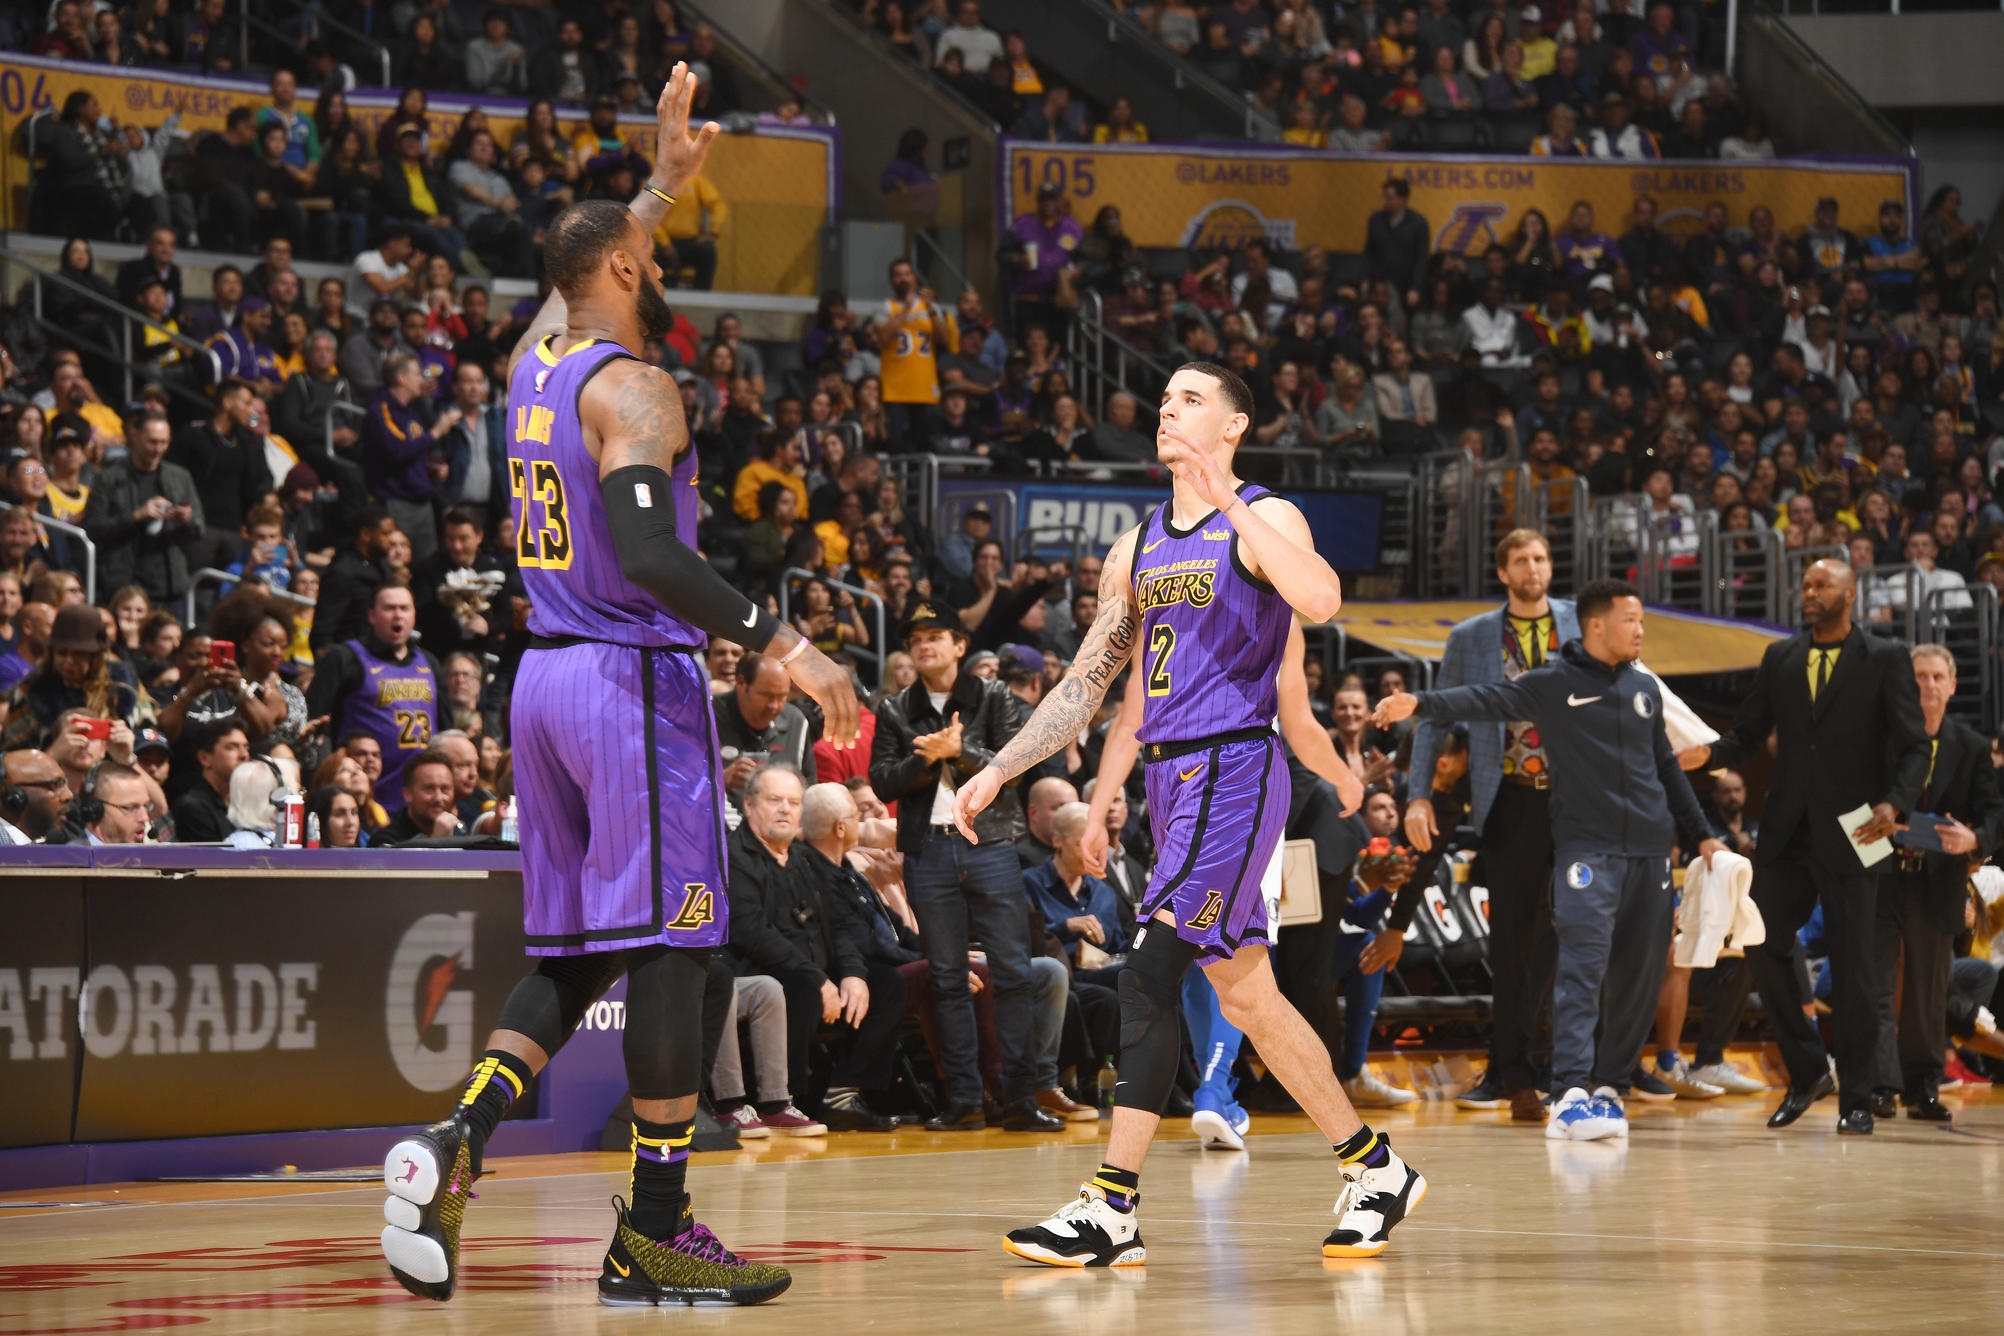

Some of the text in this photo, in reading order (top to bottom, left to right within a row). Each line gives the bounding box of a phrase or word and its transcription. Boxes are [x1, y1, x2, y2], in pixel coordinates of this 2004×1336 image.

[1018, 157, 1095, 198] 105
[1176, 161, 1291, 188] @LAKERS
[1386, 167, 1535, 191] LAKERS.COM
[1630, 172, 1746, 195] @LAKERS
[508, 457, 574, 571] 23
[1030, 500, 1136, 545] BUD
[1203, 529, 1230, 541] wish
[1148, 559, 1218, 577] LOS ANGELES
[1136, 570, 1216, 620] LAKERS
[1085, 616, 1136, 689] FEAR GOD
[1148, 624, 1176, 697] 2
[394, 709, 432, 750] 23
[666, 883, 714, 930] LA
[1185, 889, 1224, 930] LA
[0, 963, 318, 1060] ATORADE
[385, 911, 478, 1092] G
[576, 1000, 627, 1031] YOT
